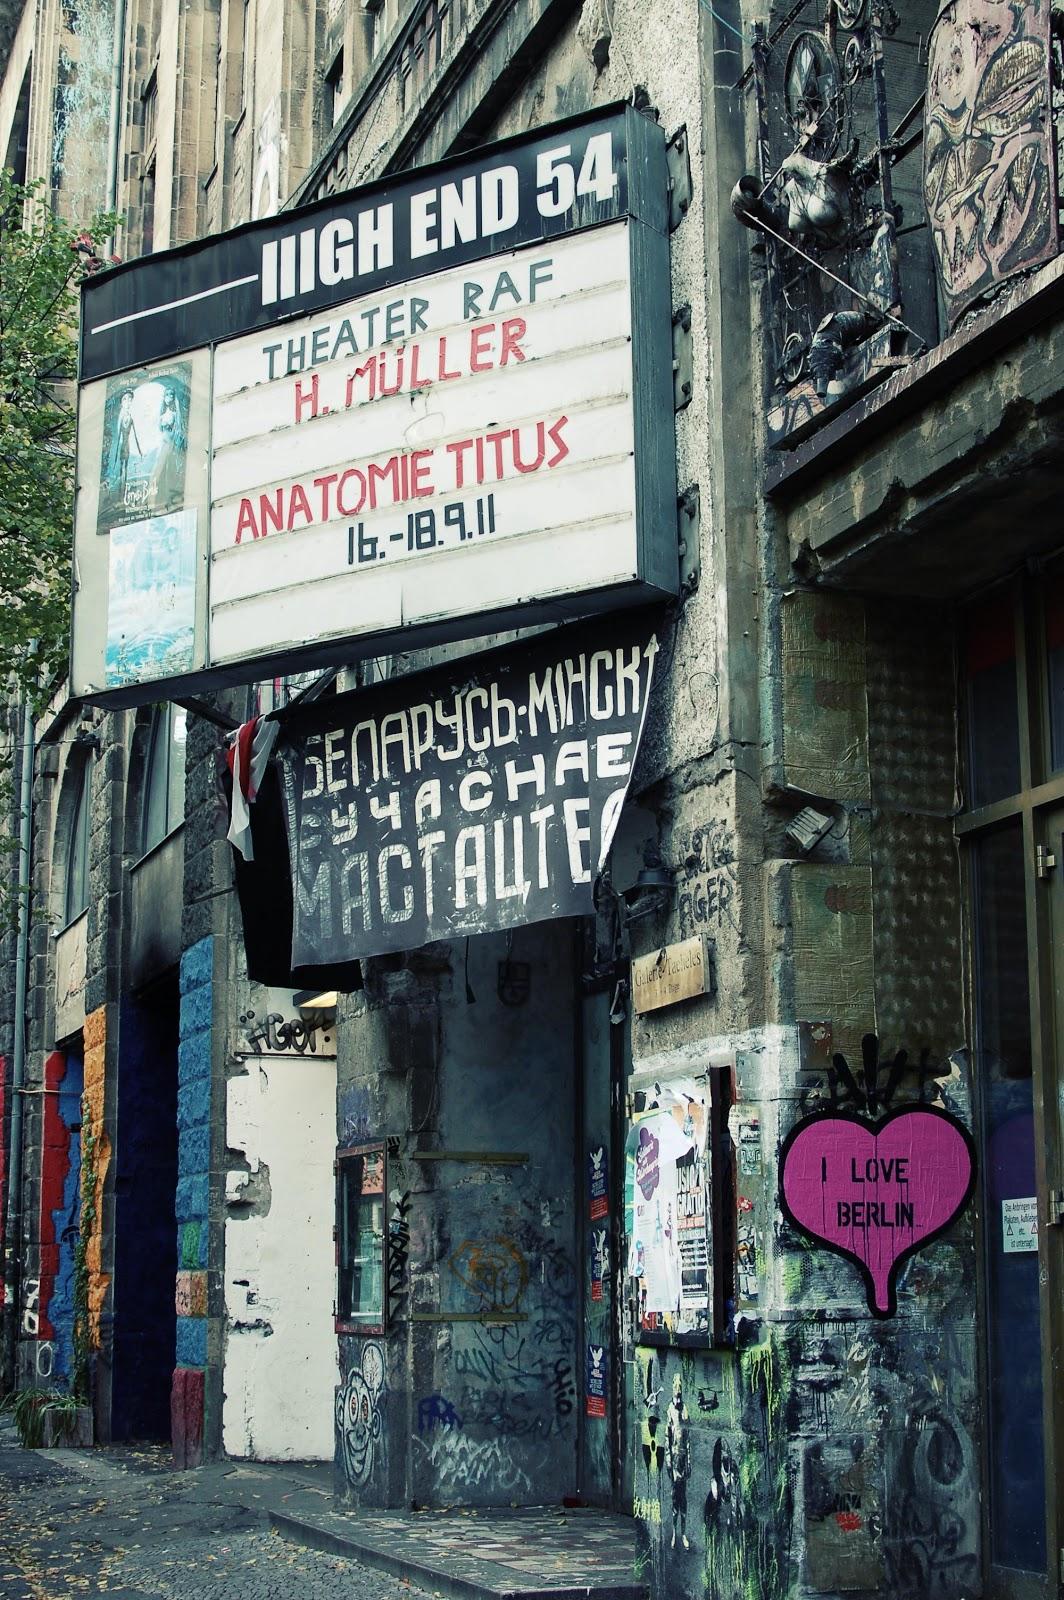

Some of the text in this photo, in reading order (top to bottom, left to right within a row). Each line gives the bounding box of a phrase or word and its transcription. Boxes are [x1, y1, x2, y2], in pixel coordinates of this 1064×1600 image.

[410, 165, 519, 260] END
[536, 132, 618, 218] 54
[262, 259, 554, 380] THEATER RAF
[295, 317, 528, 425] H. MÜLLER
[234, 415, 571, 544] ANATOMIE TITUS
[821, 1156, 909, 1183] I LOVE
